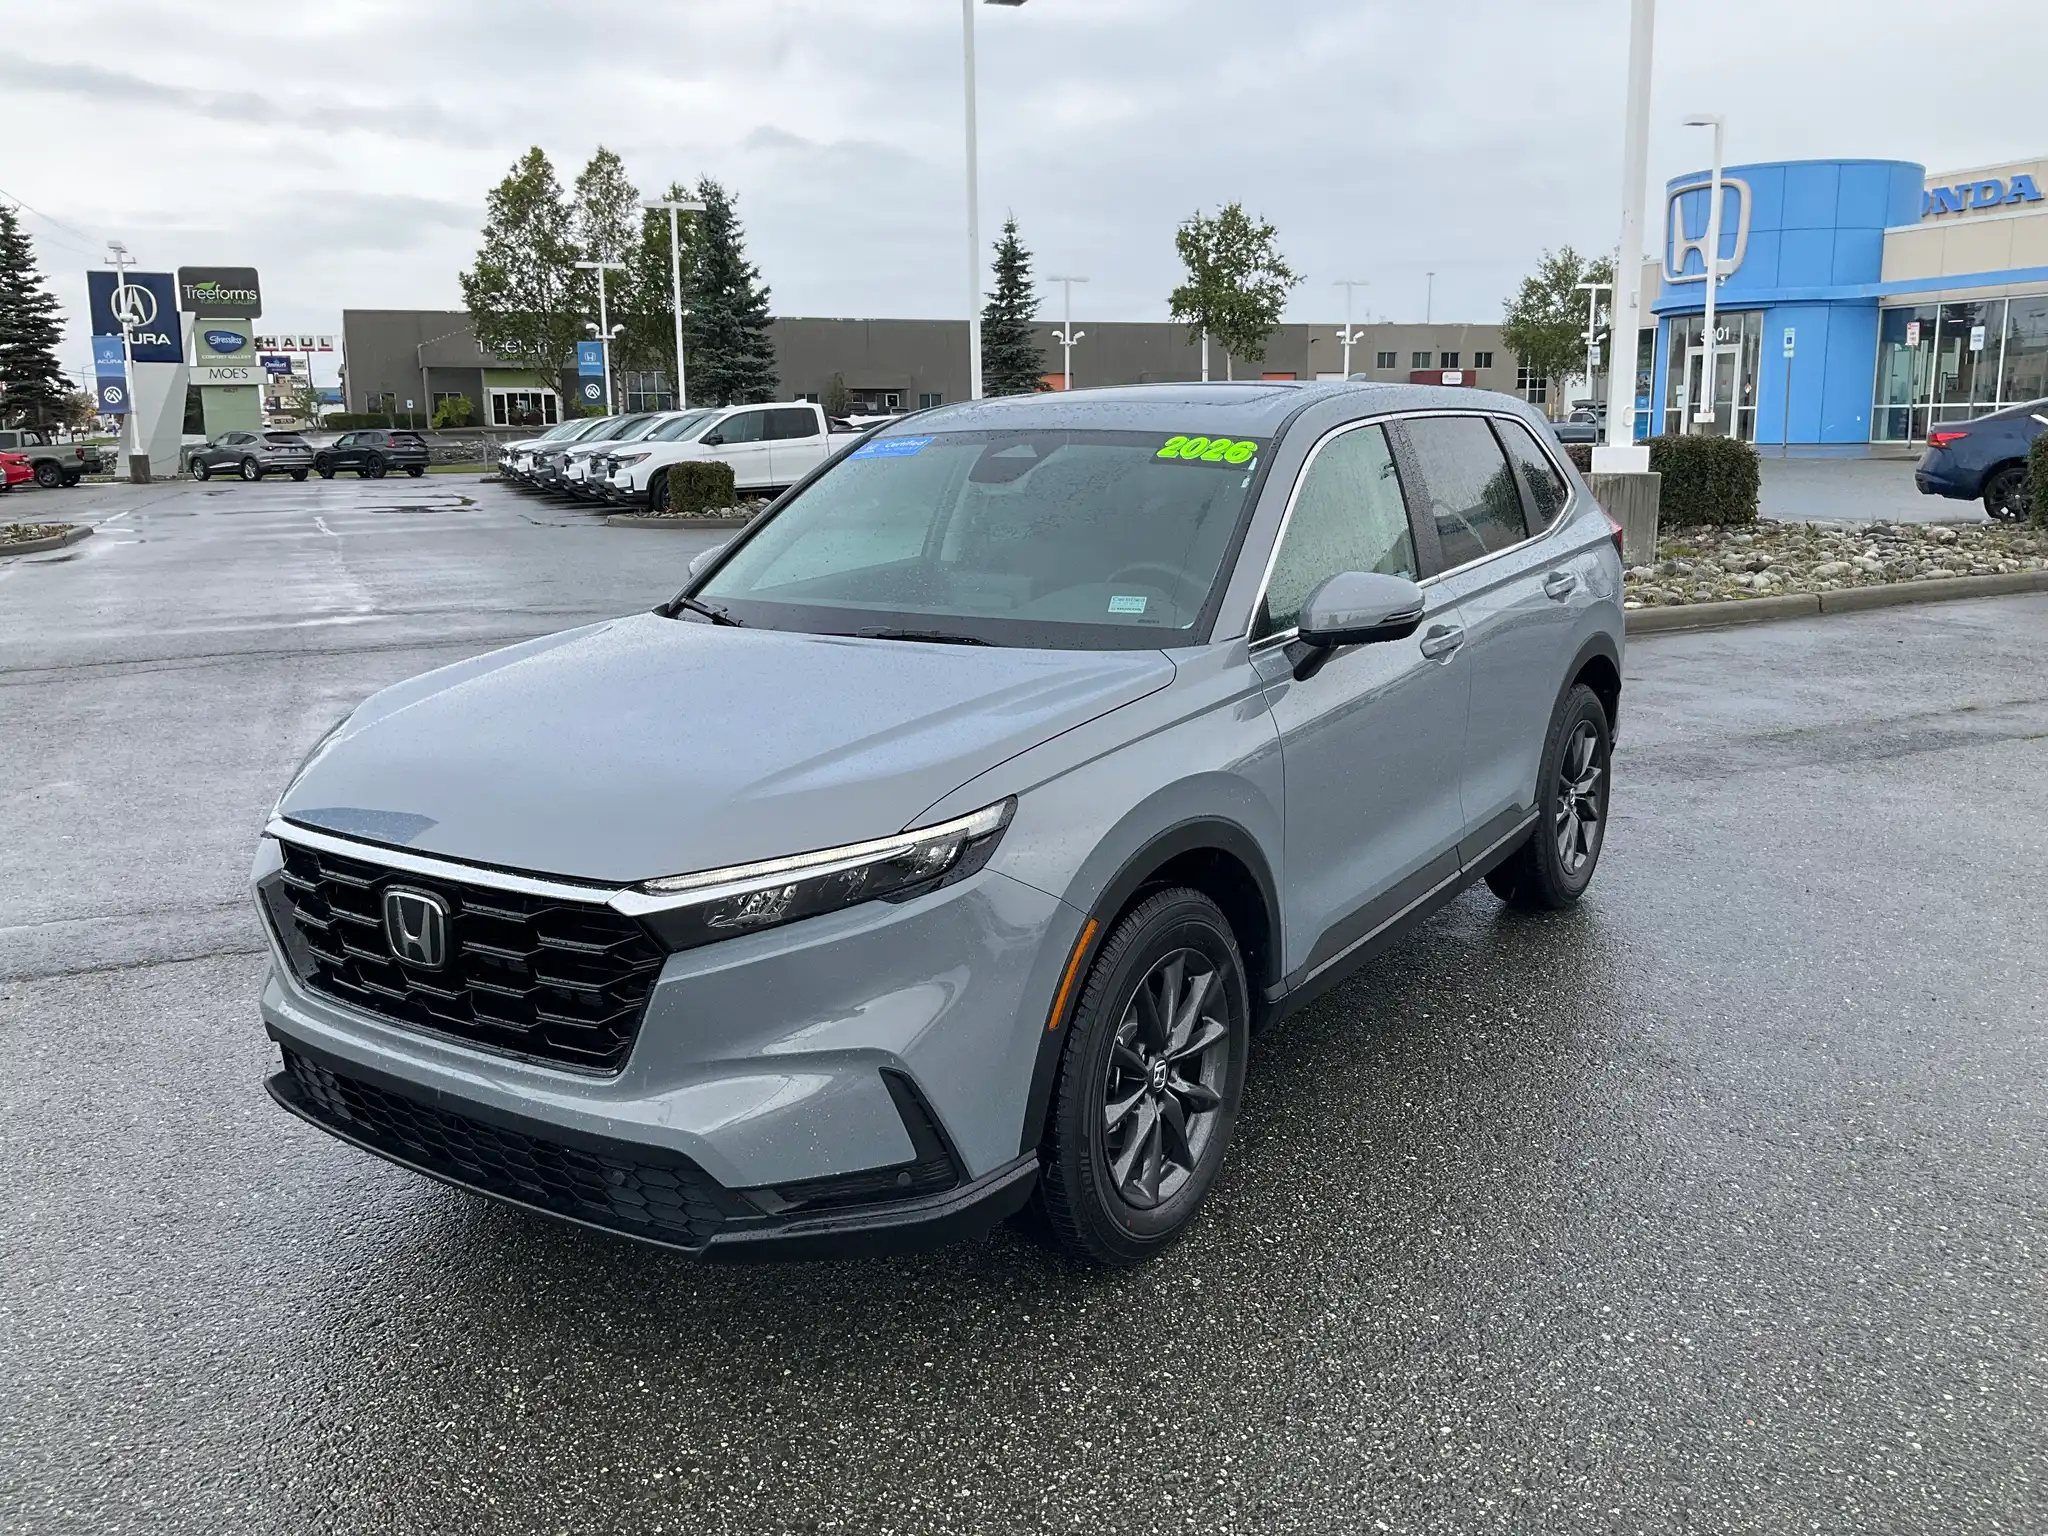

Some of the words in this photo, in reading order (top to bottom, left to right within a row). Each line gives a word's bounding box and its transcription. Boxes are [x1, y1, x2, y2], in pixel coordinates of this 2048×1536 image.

[1921, 174, 2044, 217] NDA
[182, 284, 258, 300] Treeforms
[1700, 326, 1730, 342] 501
[208, 367, 249, 379] MOE'S
[1157, 436, 1258, 464] 2026
